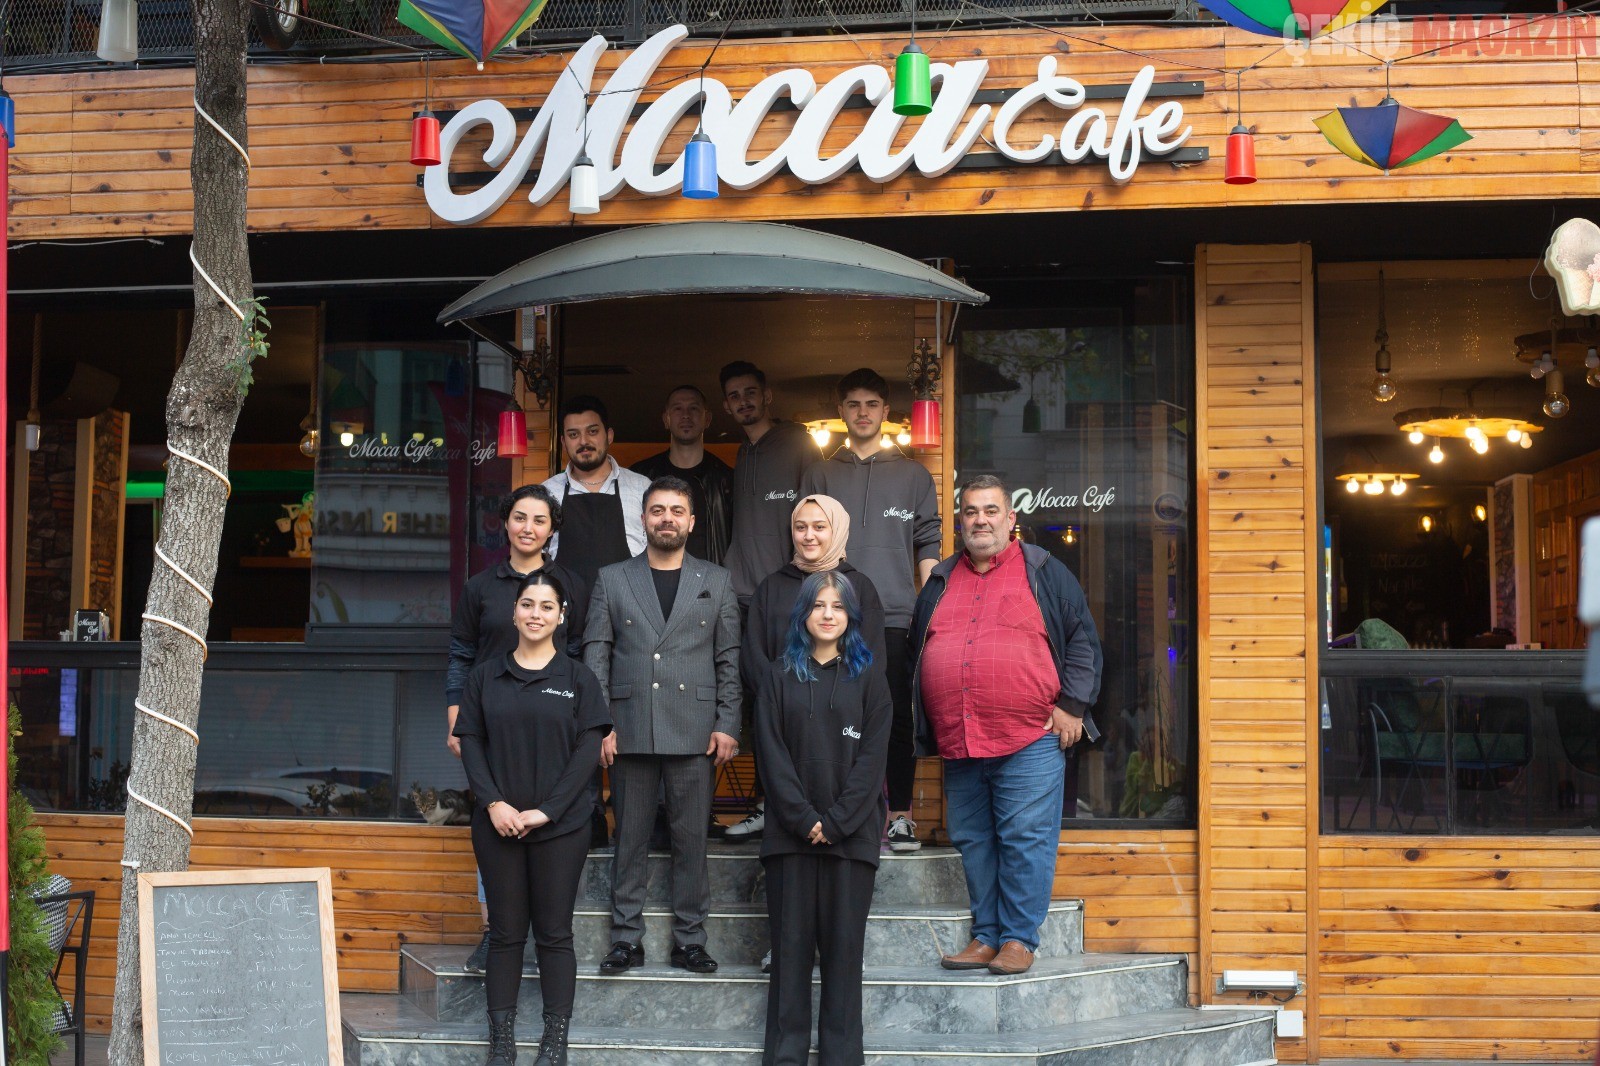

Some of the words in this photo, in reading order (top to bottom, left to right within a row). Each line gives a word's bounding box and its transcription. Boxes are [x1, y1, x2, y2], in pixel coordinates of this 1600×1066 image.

[424, 24, 992, 224] Mocca
[993, 55, 1192, 184] Cafe
[349, 438, 400, 458] Mocca
[404, 437, 433, 463] Cafe
[467, 439, 496, 465] Cafe
[1029, 487, 1078, 508] Mocca
[1082, 485, 1115, 512] Cafe
